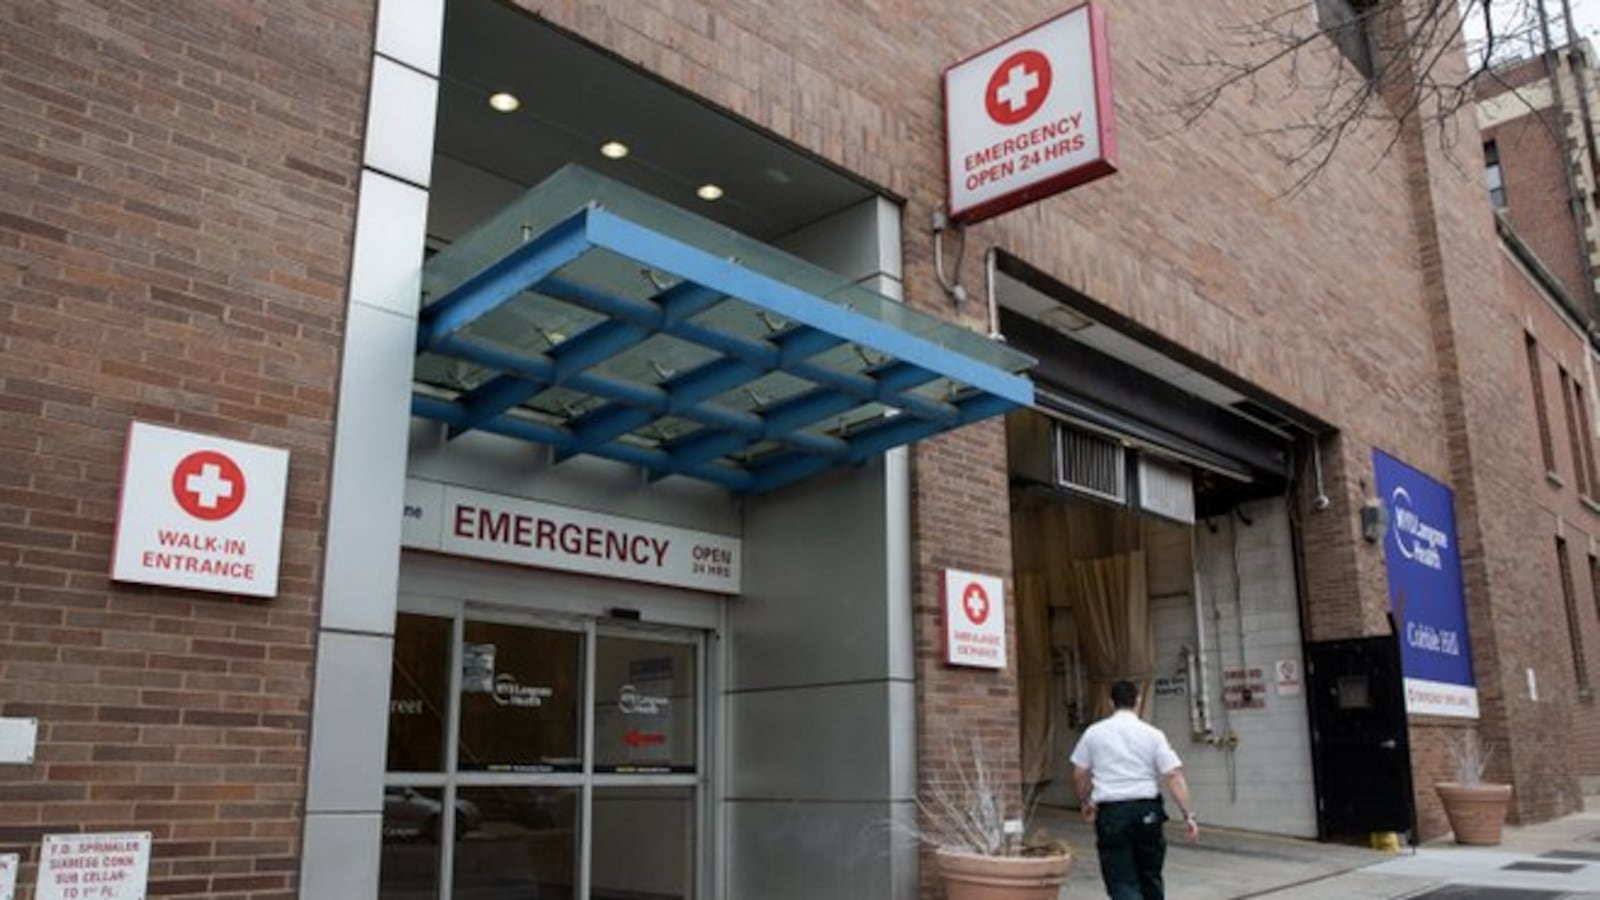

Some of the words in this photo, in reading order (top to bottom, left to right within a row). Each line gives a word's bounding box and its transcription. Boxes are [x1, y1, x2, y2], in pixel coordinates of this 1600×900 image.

[965, 112, 1082, 171] EMERGENCY
[966, 161, 1014, 190] OPEN
[1020, 151, 1041, 171] 24
[1045, 134, 1084, 161] HRS
[158, 530, 246, 555] WALK-IN
[454, 505, 669, 567] EMERGENCY
[693, 545, 731, 564] OPEN
[142, 552, 254, 580] ENTRANCE
